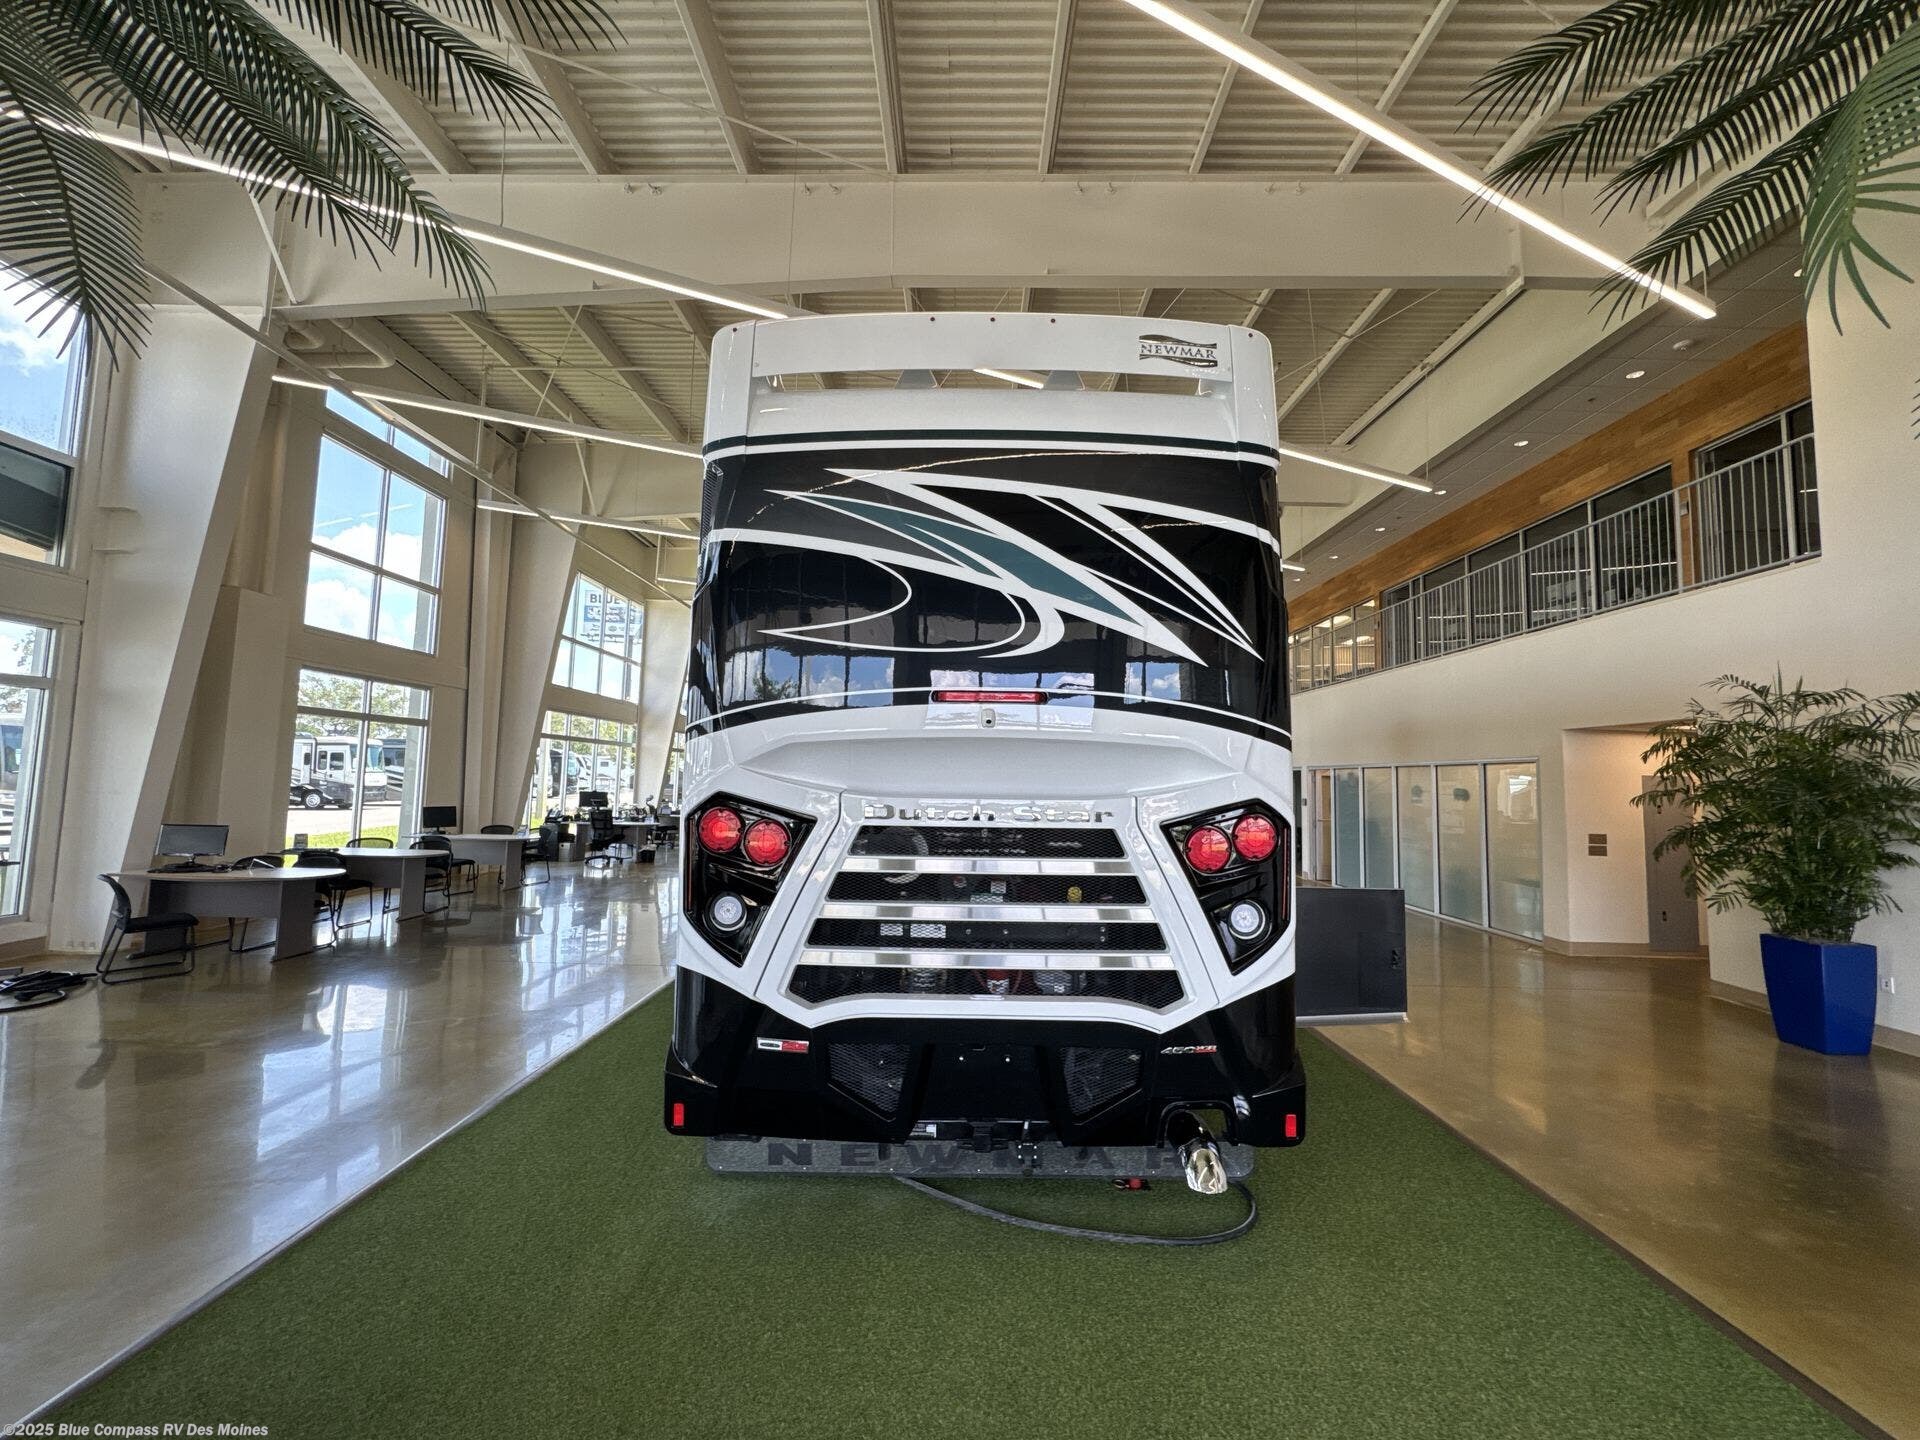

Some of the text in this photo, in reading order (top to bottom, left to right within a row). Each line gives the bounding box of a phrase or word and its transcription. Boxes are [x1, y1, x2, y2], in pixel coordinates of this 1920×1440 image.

[1140, 343, 1216, 359] NEWMAR
[864, 804, 1114, 823] Dutch Star
